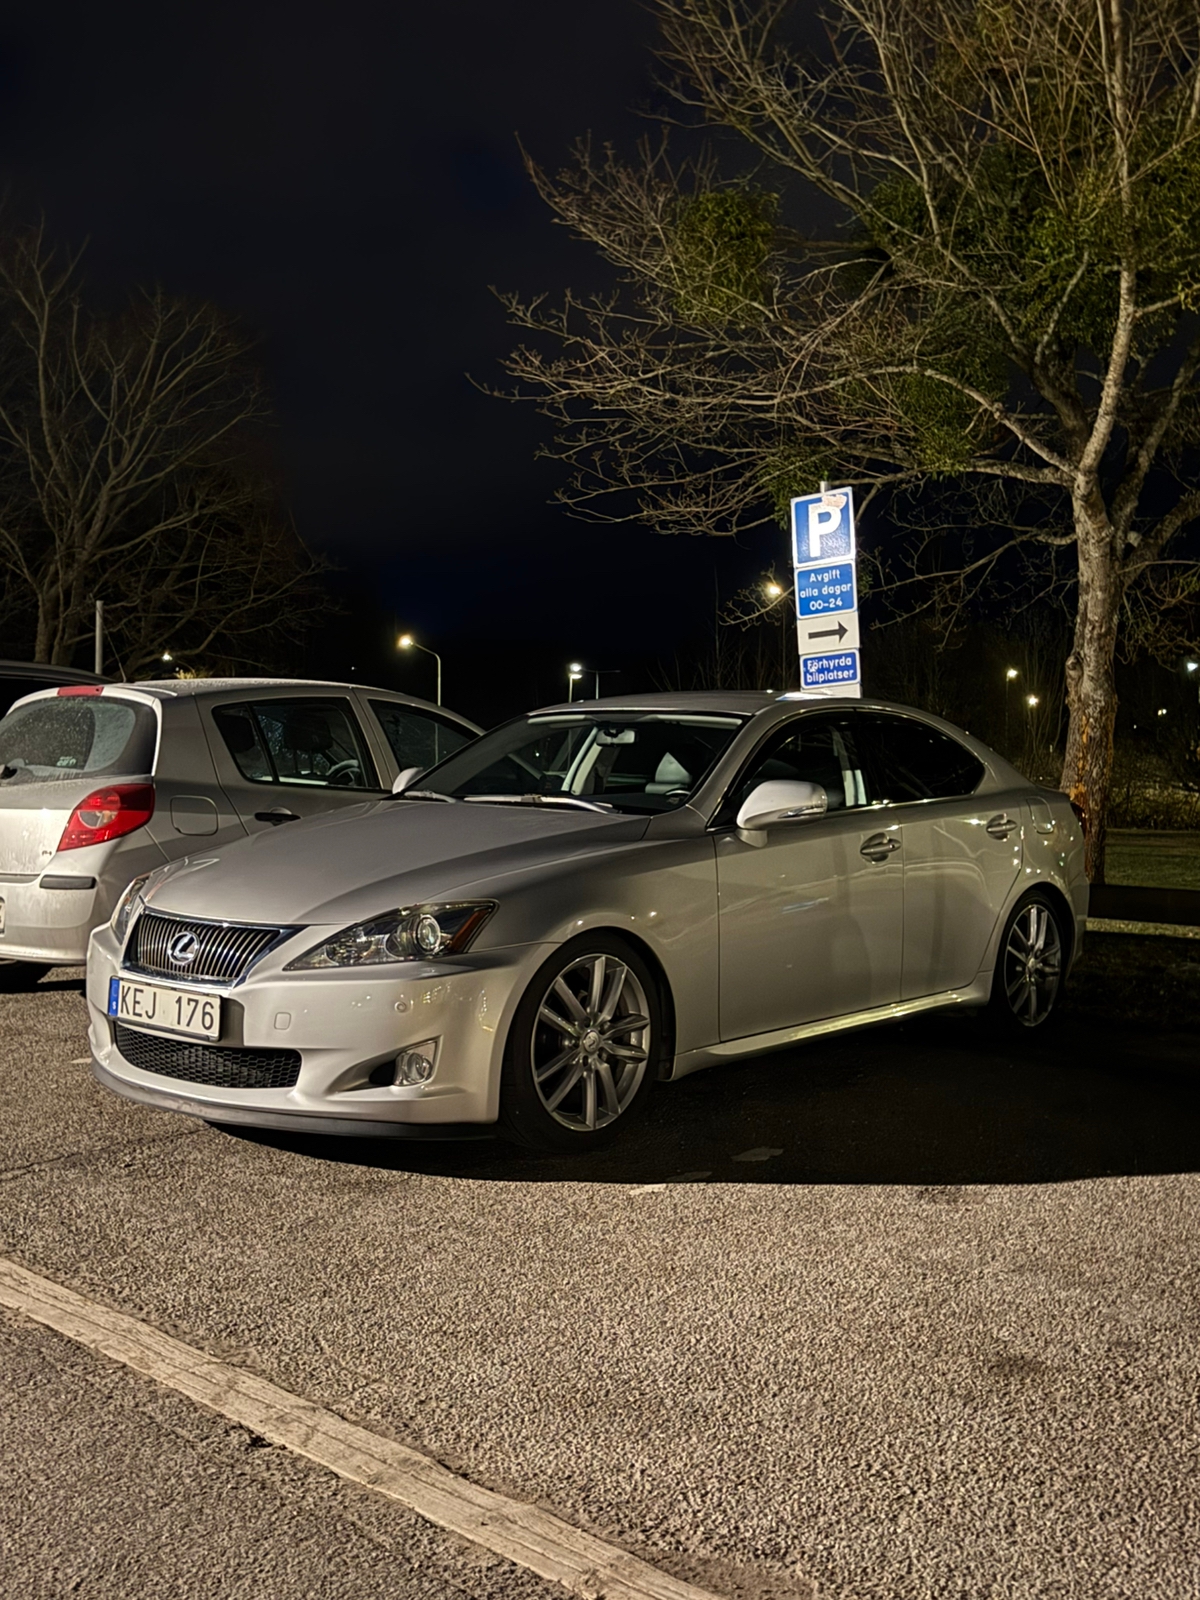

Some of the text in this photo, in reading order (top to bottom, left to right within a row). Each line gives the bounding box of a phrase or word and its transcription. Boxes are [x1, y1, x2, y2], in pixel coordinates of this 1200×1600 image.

[808, 501, 842, 558] P
[809, 569, 840, 582] Avgift
[800, 583, 852, 598] alla dagar
[809, 597, 843, 610] 00-24
[807, 656, 852, 671] Förhyrda
[806, 669, 854, 683] bilplatser
[120, 984, 215, 1031] KEJ 176
